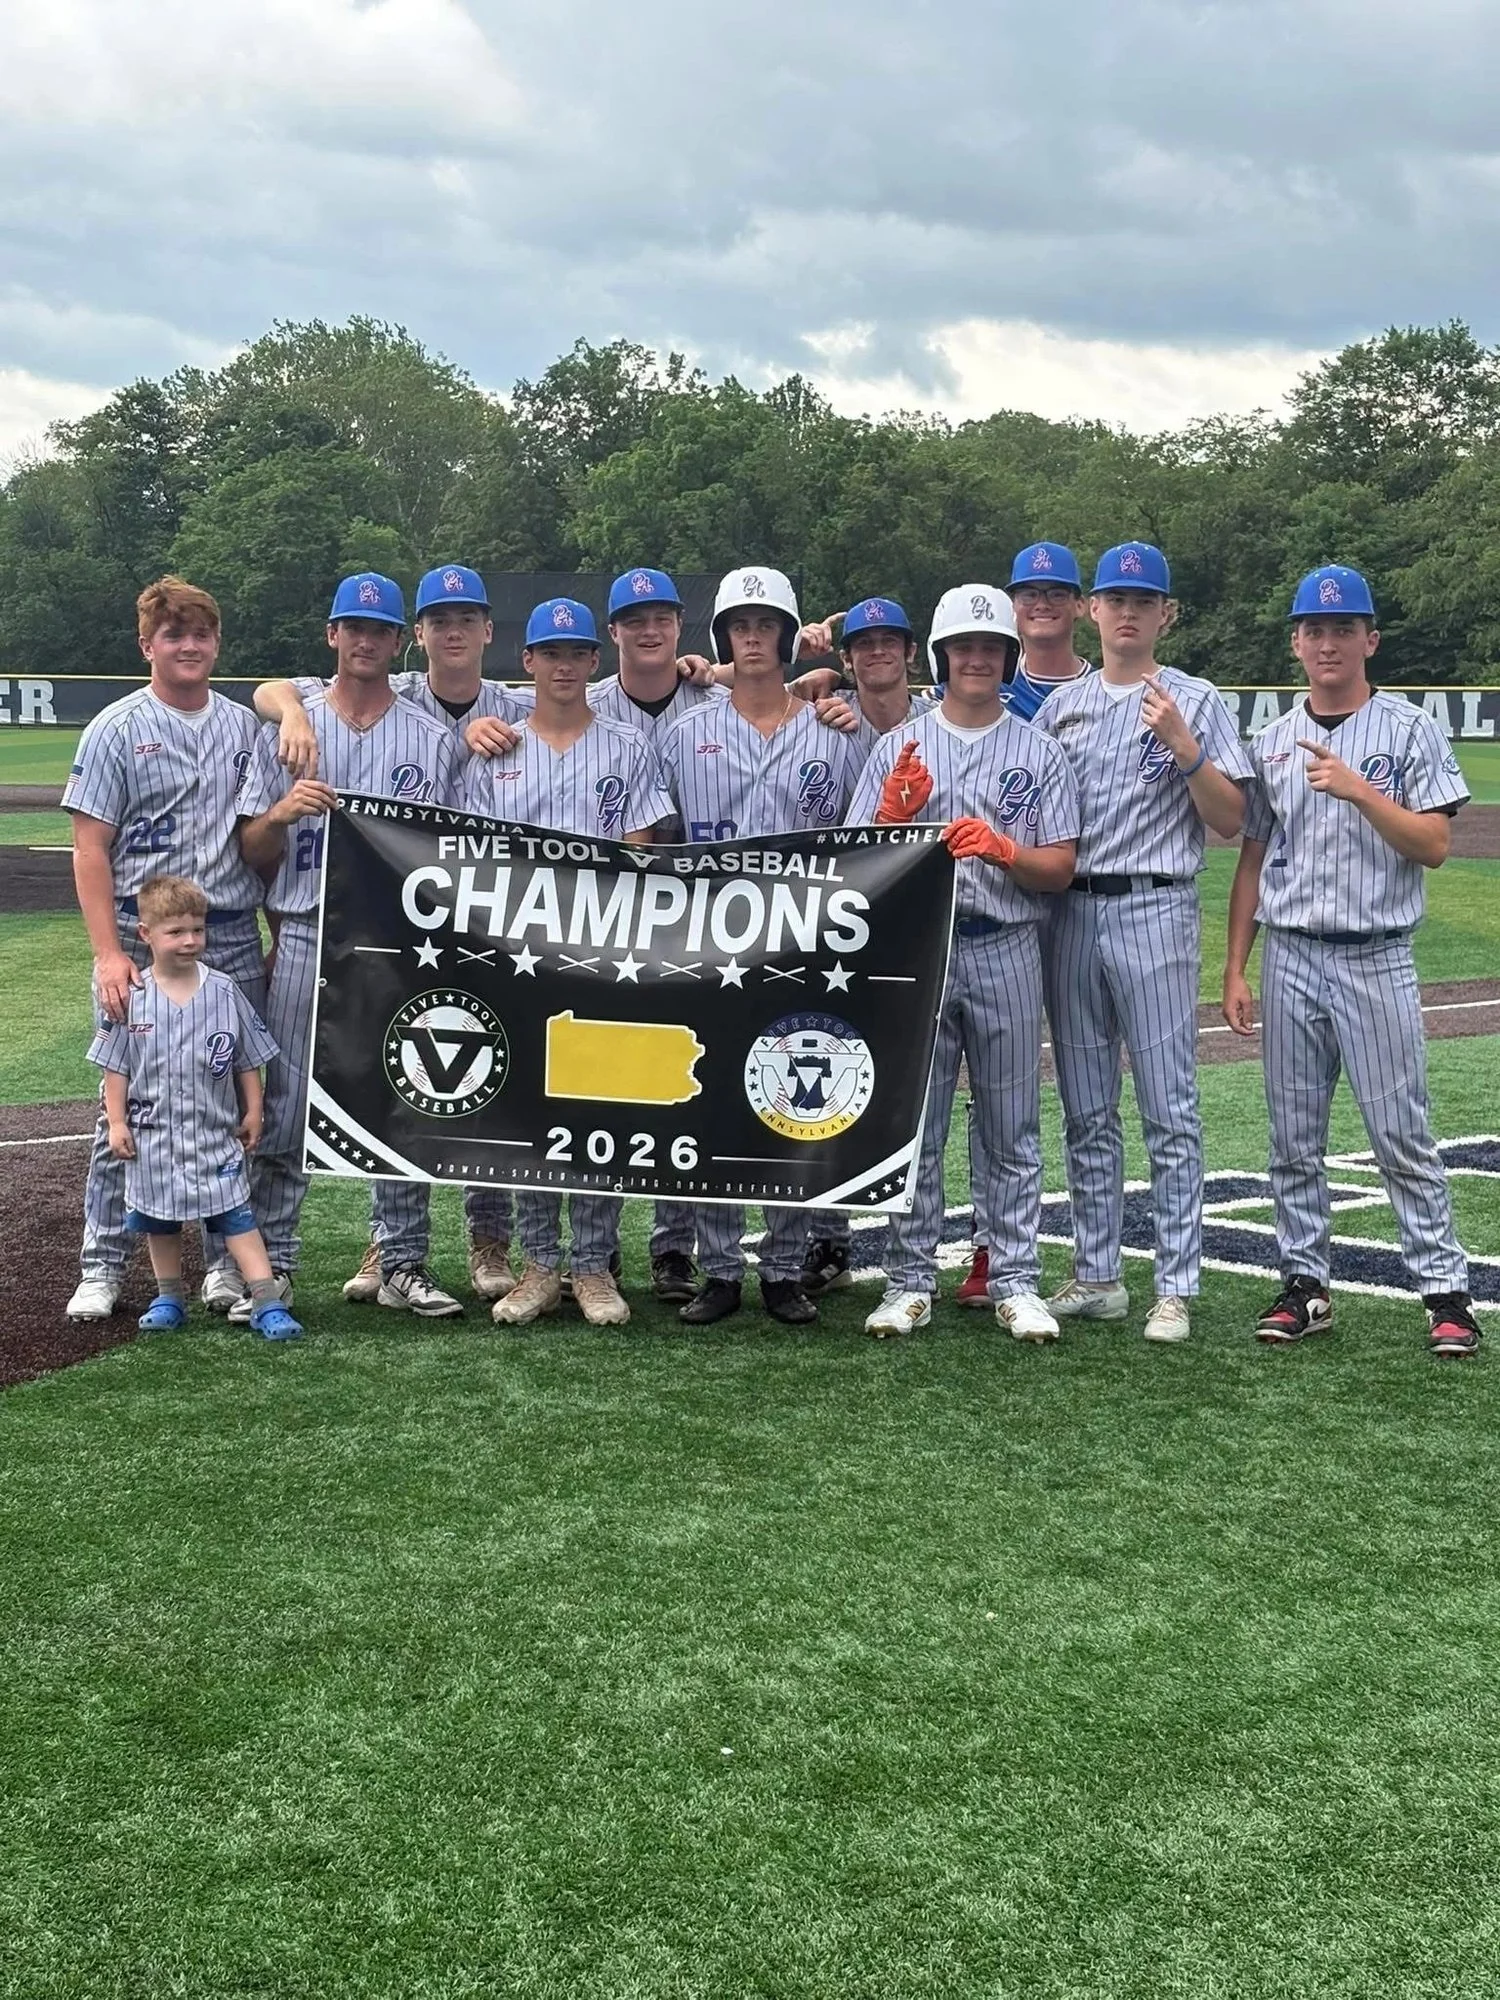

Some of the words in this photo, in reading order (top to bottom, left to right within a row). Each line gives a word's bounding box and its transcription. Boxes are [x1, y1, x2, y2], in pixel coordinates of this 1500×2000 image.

[798, 757, 839, 821] PA
[997, 765, 1042, 831] PA
[126, 814, 177, 854] 22
[438, 835, 512, 860] FIVE
[520, 837, 611, 863] TOOL
[673, 851, 844, 882] BASEBALL
[401, 865, 871, 954] CHAMPIONS
[401, 994, 439, 1022] FIVE
[461, 996, 497, 1030] TOOL
[761, 1017, 800, 1047] FIVE
[823, 1018, 862, 1051] TOOL
[396, 1076, 495, 1114] BASEBALL
[754, 1097, 862, 1136] PENNSYLVANIA
[545, 1126, 700, 1171] 2026
